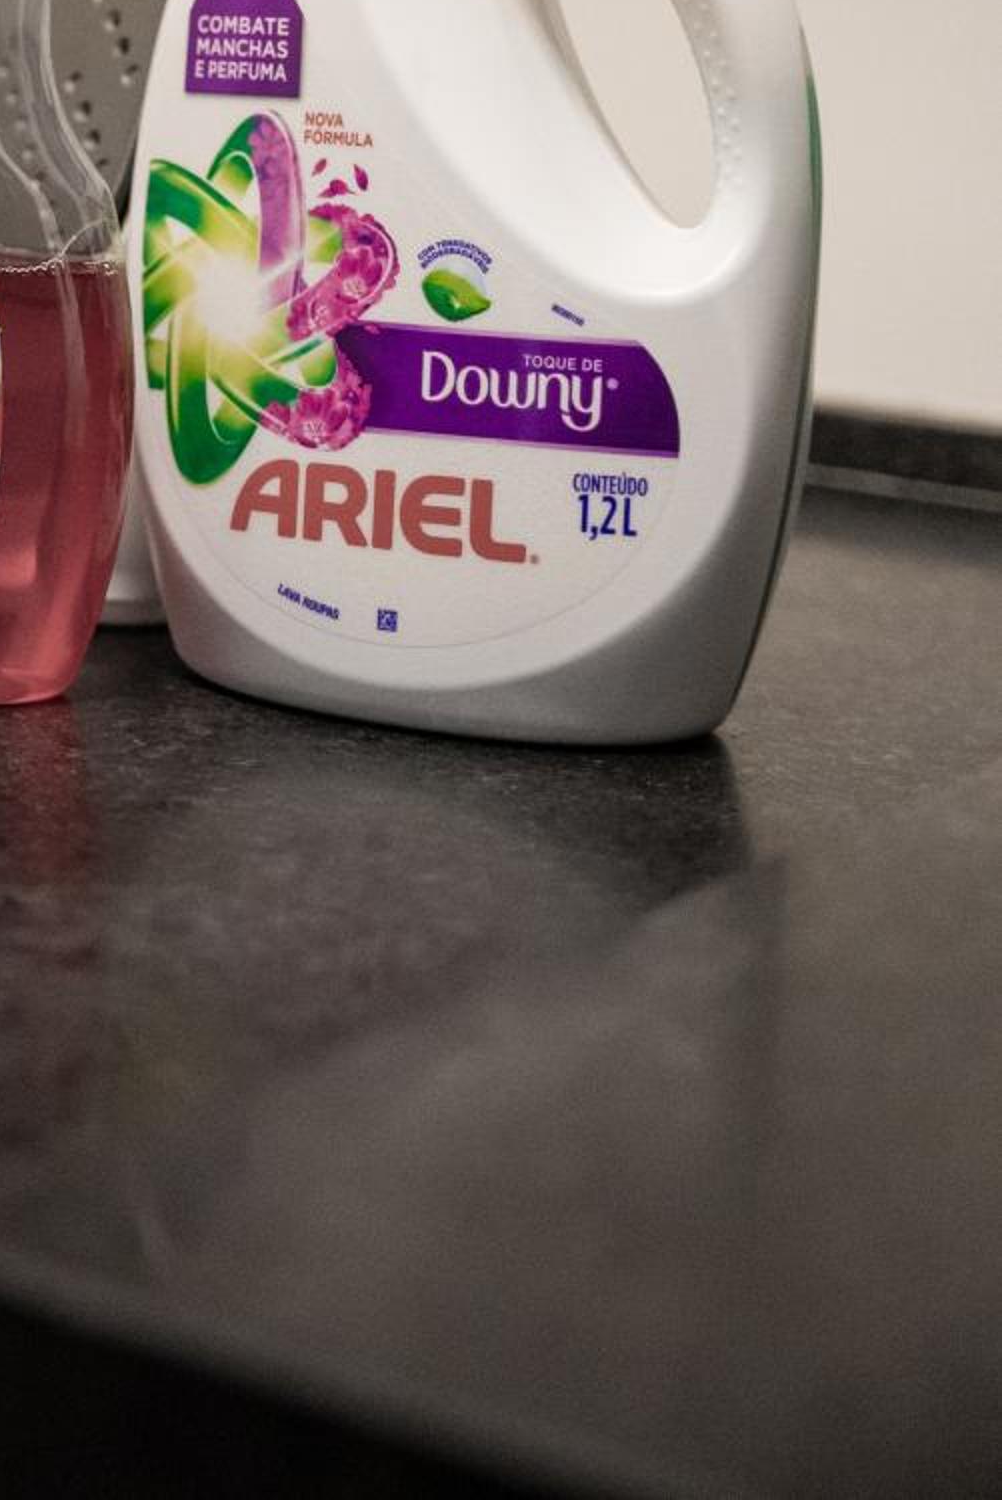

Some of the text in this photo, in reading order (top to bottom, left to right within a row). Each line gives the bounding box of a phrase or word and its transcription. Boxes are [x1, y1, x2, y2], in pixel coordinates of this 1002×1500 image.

[197, 15, 290, 36] COMBATE
[196, 38, 289, 59] MANCHAS
[195, 60, 287, 82] E PERFUMA
[304, 112, 344, 127] NOVA
[523, 354, 603, 373] TOQUE DE
[421, 350, 603, 432] Downy
[572, 471, 649, 497] CONTEÚDO
[229, 458, 527, 564] ARIEL
